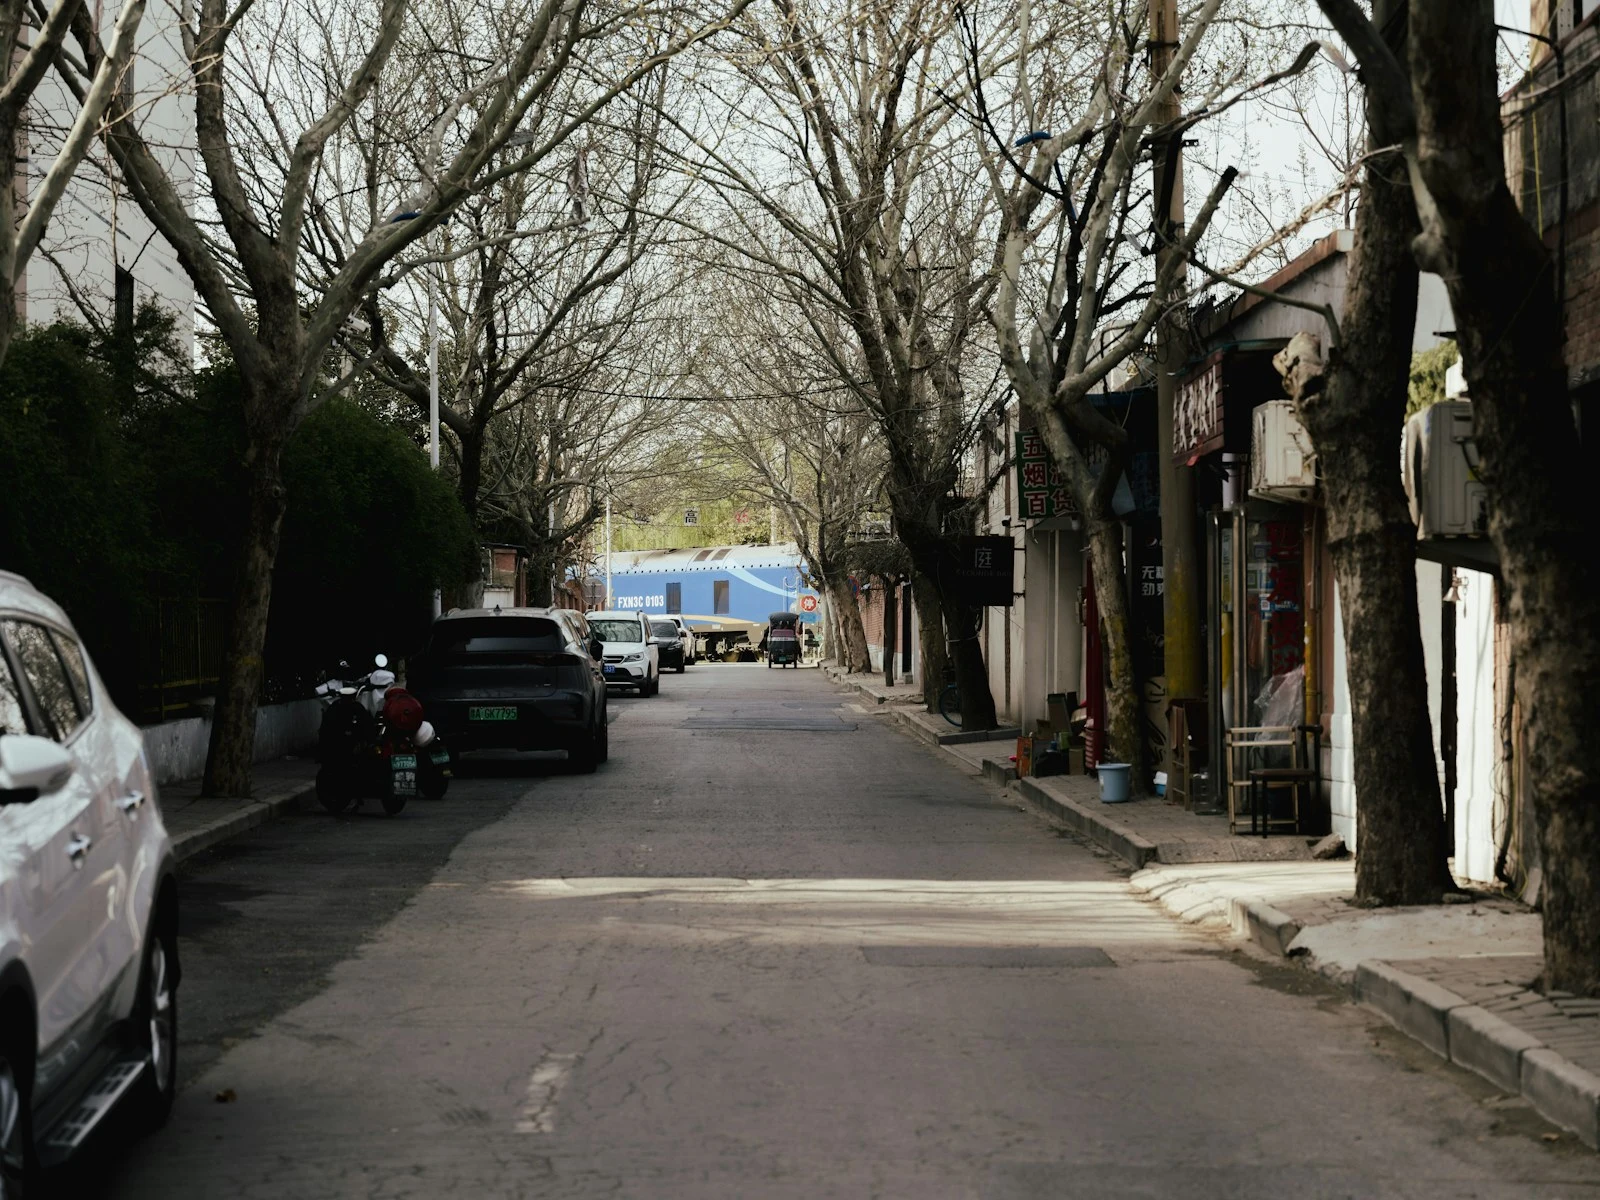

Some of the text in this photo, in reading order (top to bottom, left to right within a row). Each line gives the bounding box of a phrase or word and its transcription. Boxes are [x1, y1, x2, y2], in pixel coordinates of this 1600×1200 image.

[1024, 488, 1075, 516] 百货
[685, 509, 698, 524] 高
[975, 546, 992, 569] 庭
[618, 595, 664, 609] FXN3C 0103
